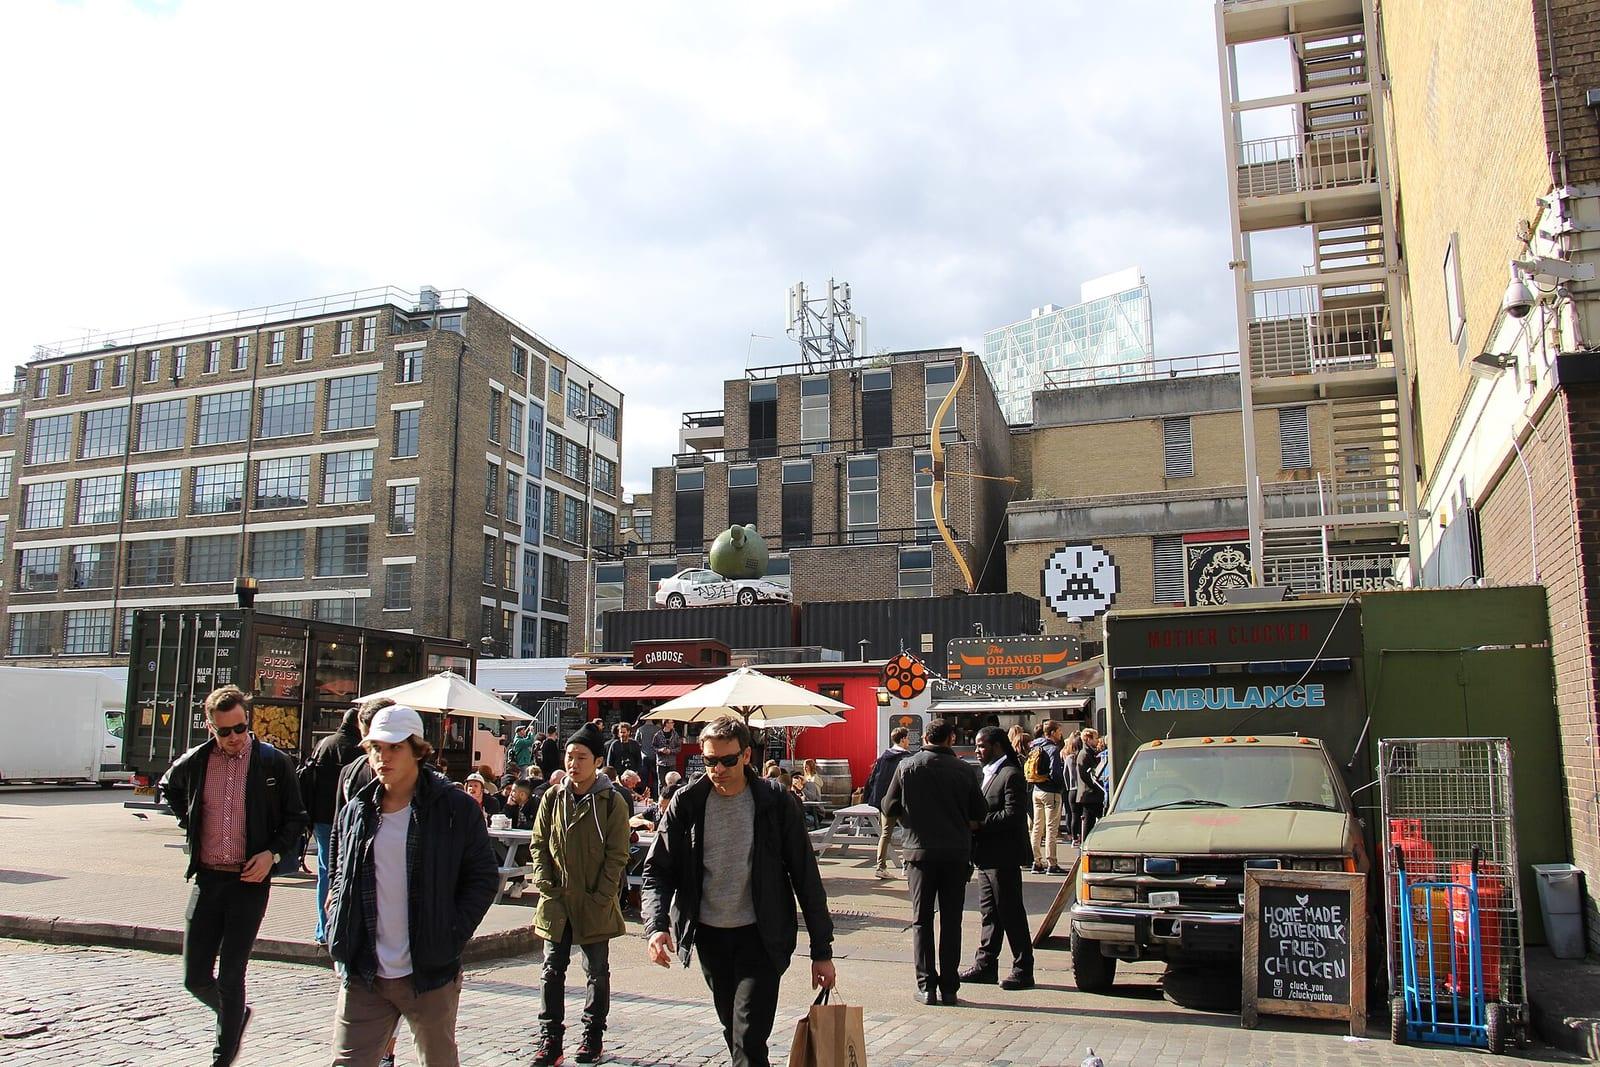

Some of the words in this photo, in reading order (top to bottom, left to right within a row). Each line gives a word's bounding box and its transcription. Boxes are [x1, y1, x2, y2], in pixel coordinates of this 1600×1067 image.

[1147, 628, 1217, 649] MOTHER
[1229, 623, 1312, 646] CLUCKER
[264, 657, 297, 669] PIZZA
[645, 650, 684, 664] CABOOSE
[986, 654, 1042, 666] ORANGE
[259, 669, 300, 681] PURIST
[987, 665, 1043, 676] BUFFALO
[959, 684, 983, 692] YORK
[1141, 684, 1326, 712] AMBULANCE
[1269, 921, 1347, 945] BUTTERMILK
[1280, 940, 1326, 959] FRIED
[1264, 957, 1346, 980] CHICKEN
[1289, 981, 1324, 992] cluck_you
[1288, 990, 1333, 1002] /cluckyoutoo
